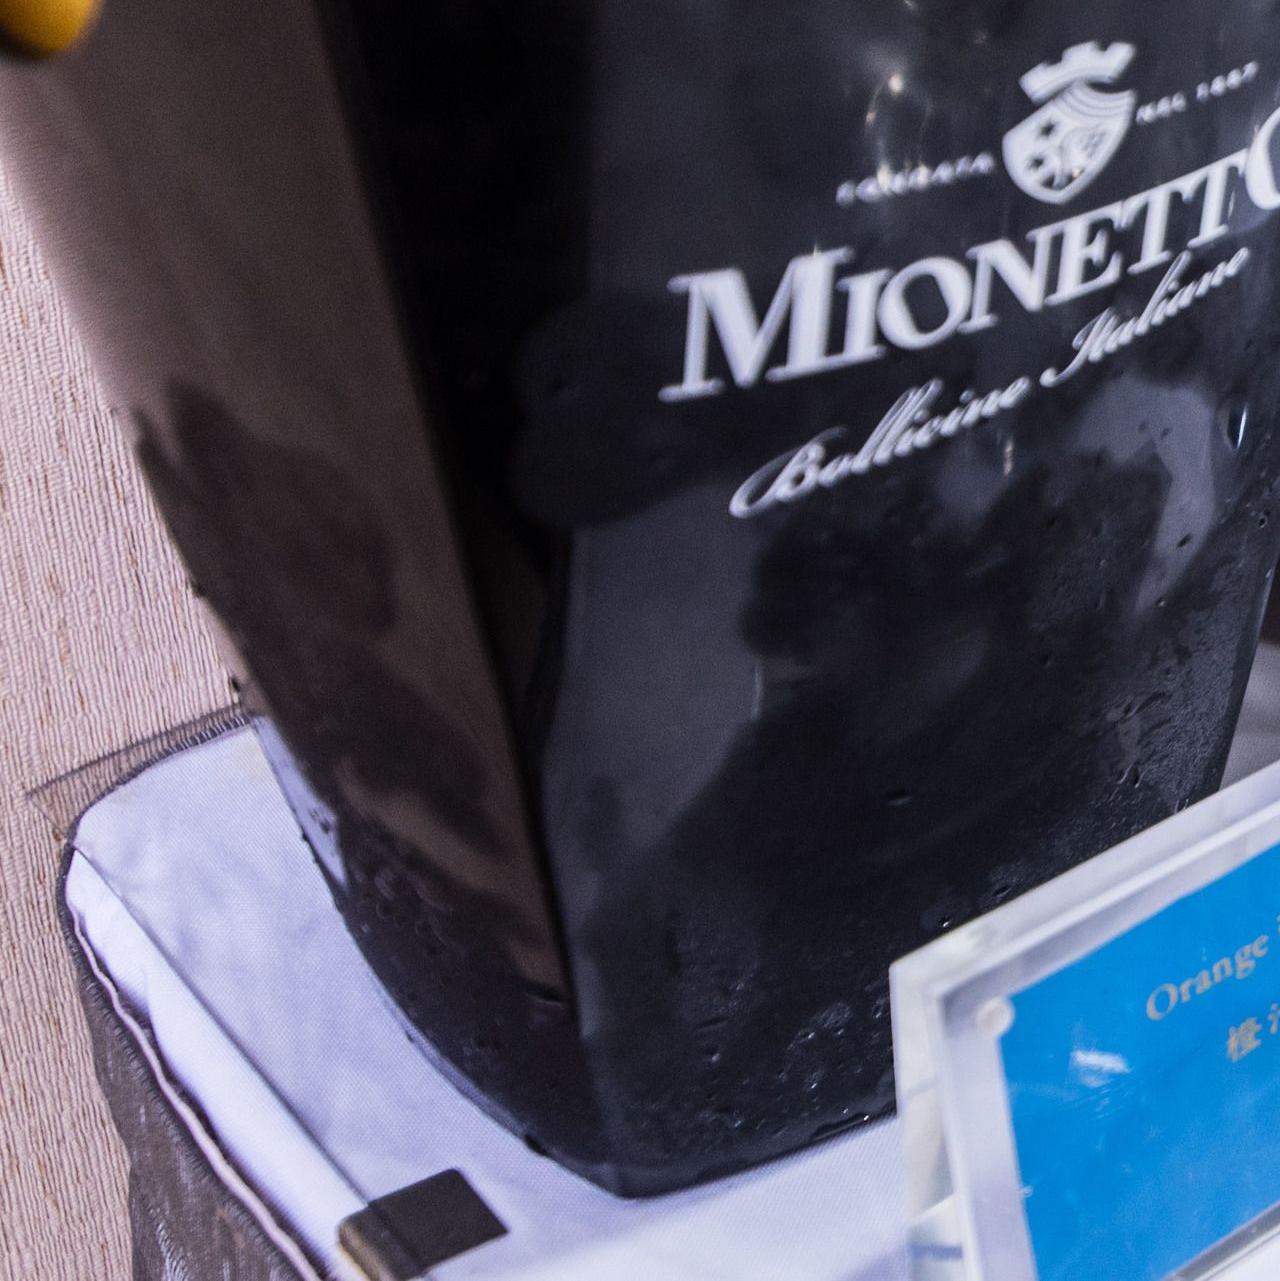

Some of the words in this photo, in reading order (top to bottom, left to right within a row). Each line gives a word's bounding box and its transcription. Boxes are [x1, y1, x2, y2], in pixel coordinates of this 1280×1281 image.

[728, 377, 1032, 518] Bollicine
[1039, 247, 1251, 388] Italiane
[1146, 934, 1269, 1021] Orange
